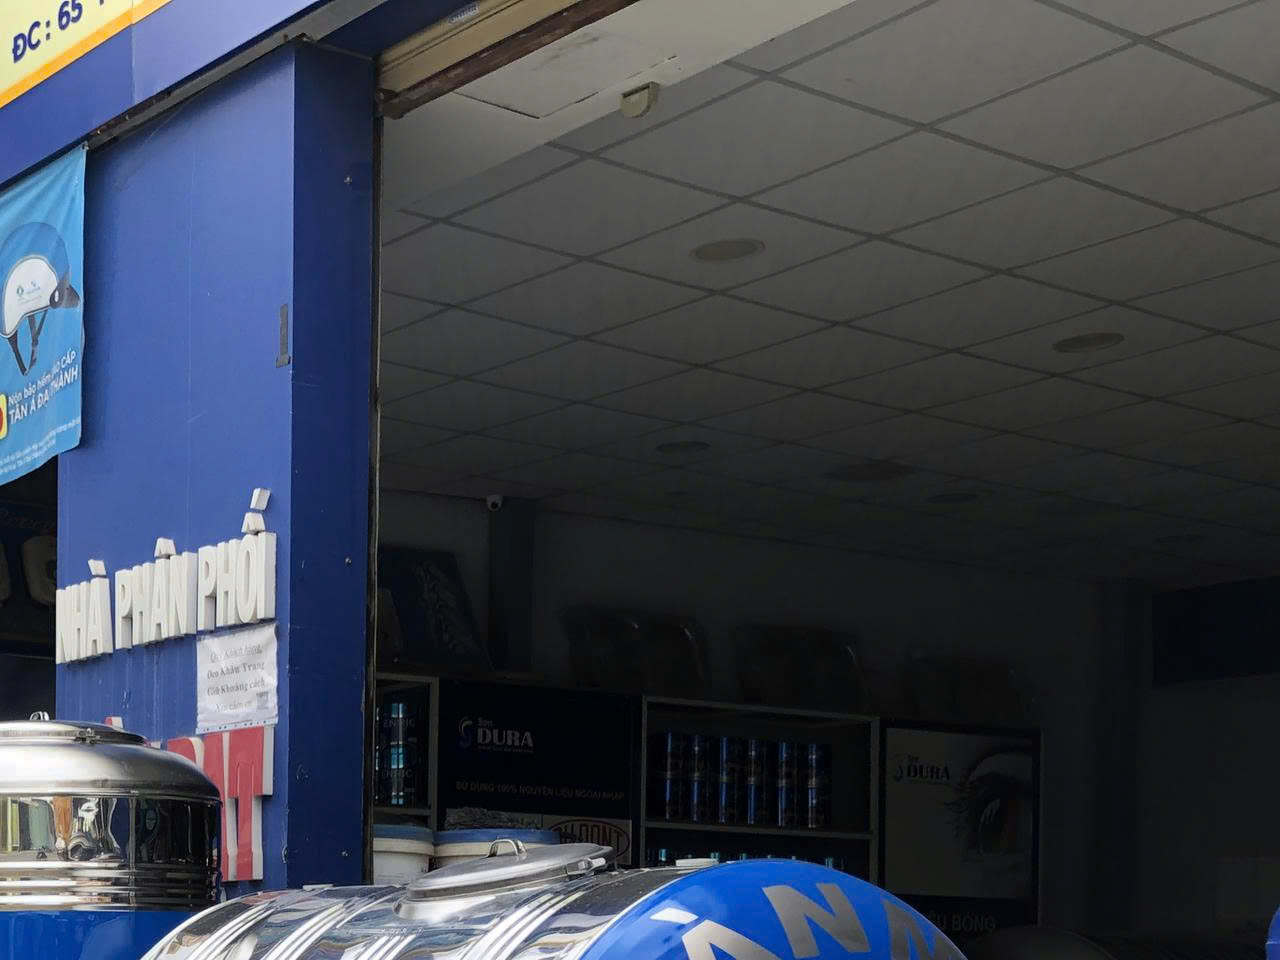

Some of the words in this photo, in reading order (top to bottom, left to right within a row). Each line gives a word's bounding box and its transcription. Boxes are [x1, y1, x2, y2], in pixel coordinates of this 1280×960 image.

[56, 558, 114, 665] NHÀ
[115, 537, 198, 650] PHÂN
[197, 487, 277, 632] PHỐI
[477, 728, 534, 748] DURA
